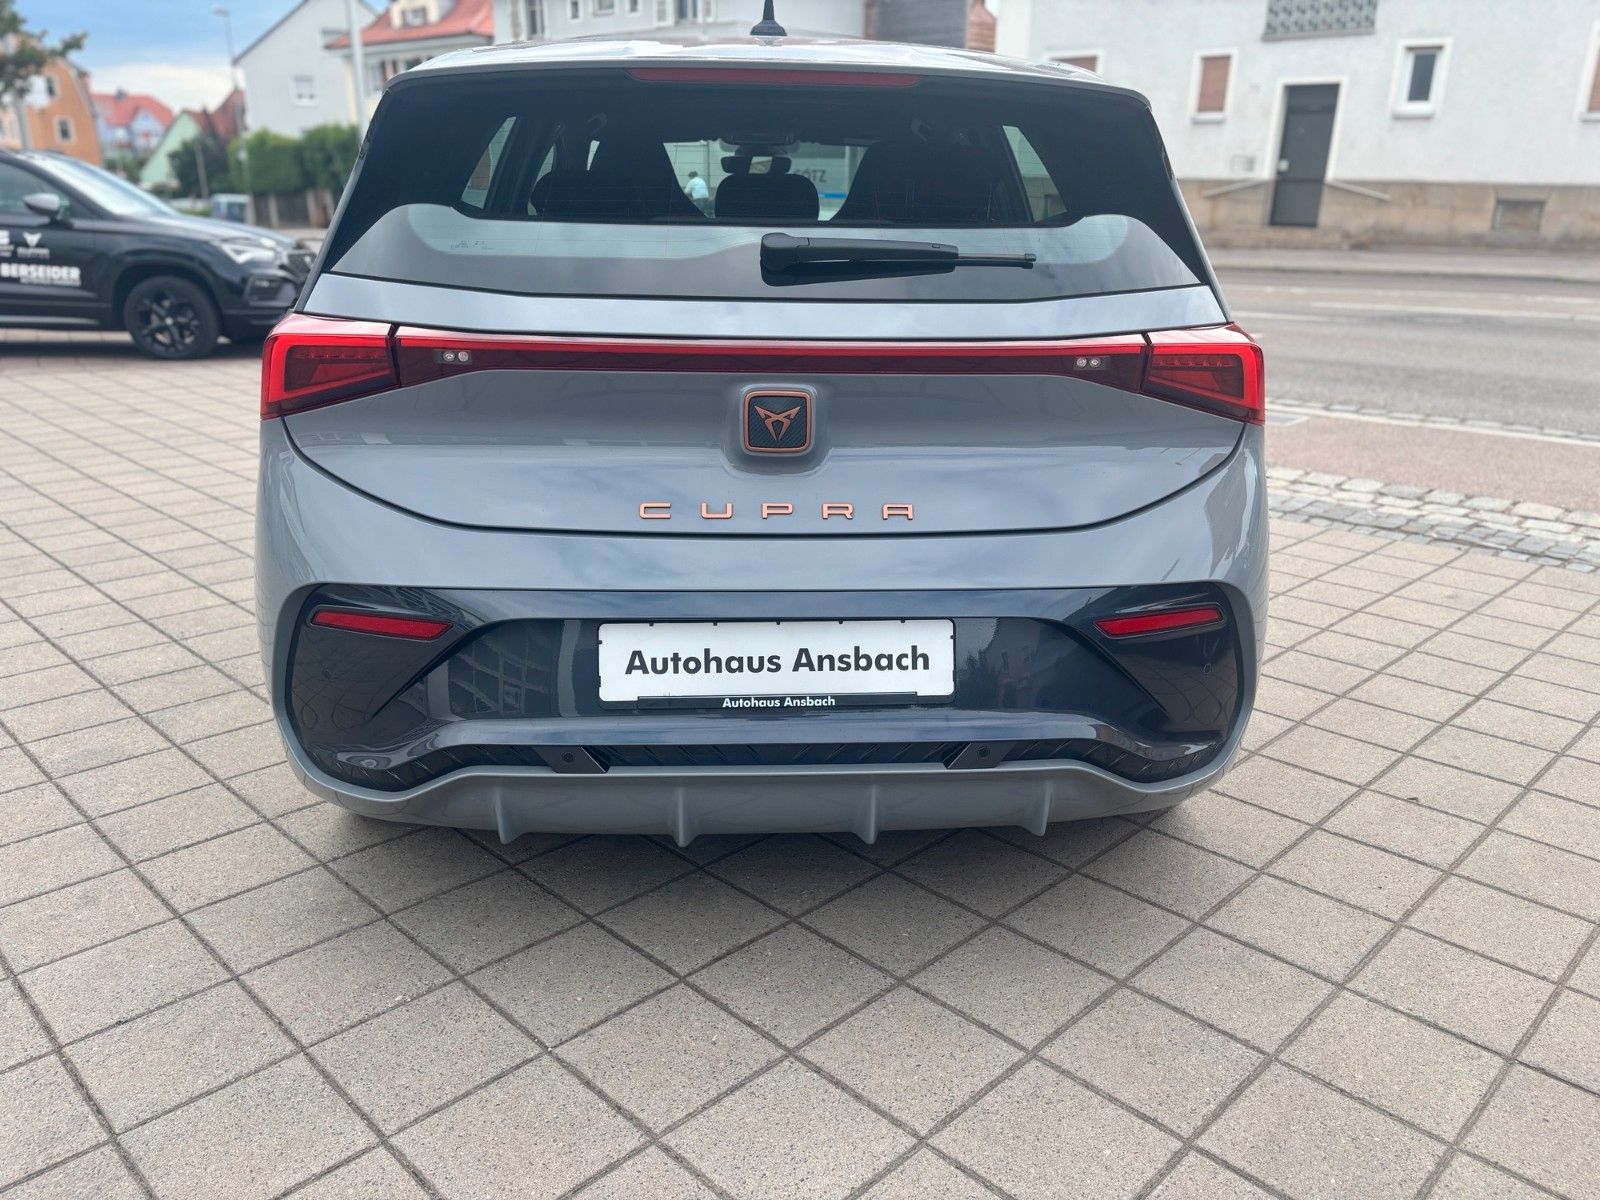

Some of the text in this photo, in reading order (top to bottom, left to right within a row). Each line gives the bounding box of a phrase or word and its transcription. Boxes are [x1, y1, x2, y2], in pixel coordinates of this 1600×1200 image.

[638, 502, 915, 520] CUPRA
[624, 644, 930, 675] Autohaus Ansbach
[722, 695, 836, 708] Autohaus Ansbach
